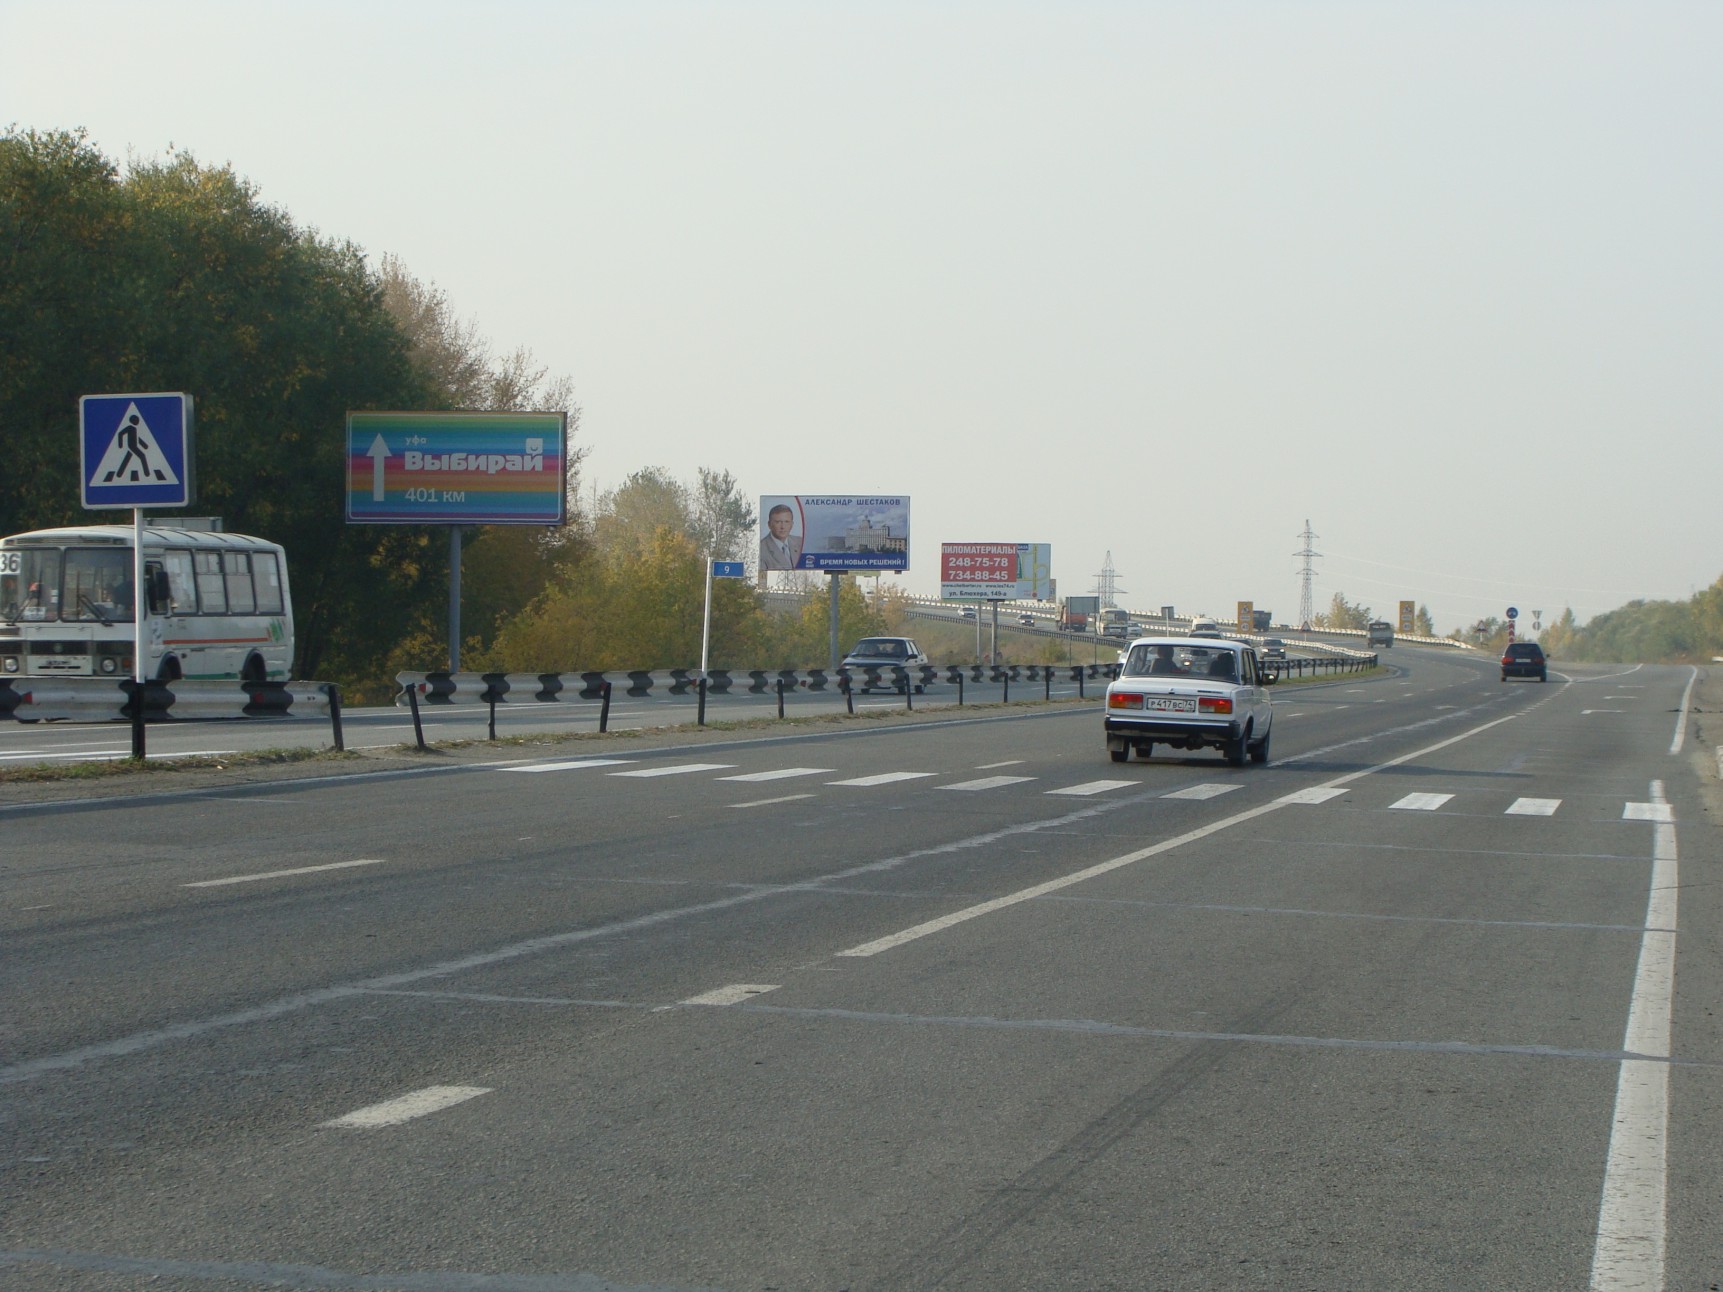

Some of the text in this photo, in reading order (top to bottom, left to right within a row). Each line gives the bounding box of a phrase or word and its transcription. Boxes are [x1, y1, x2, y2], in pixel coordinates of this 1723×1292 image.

[405, 435, 427, 446] уфа
[404, 446, 543, 474] Выбирай
[405, 487, 465, 503] 401 км
[942, 545, 1016, 554] ПИЛОМАТЕРИАЛЫ
[948, 557, 1008, 567] 248-75-78
[724, 566, 730, 574] 9
[948, 570, 1008, 580] 734-88-45
